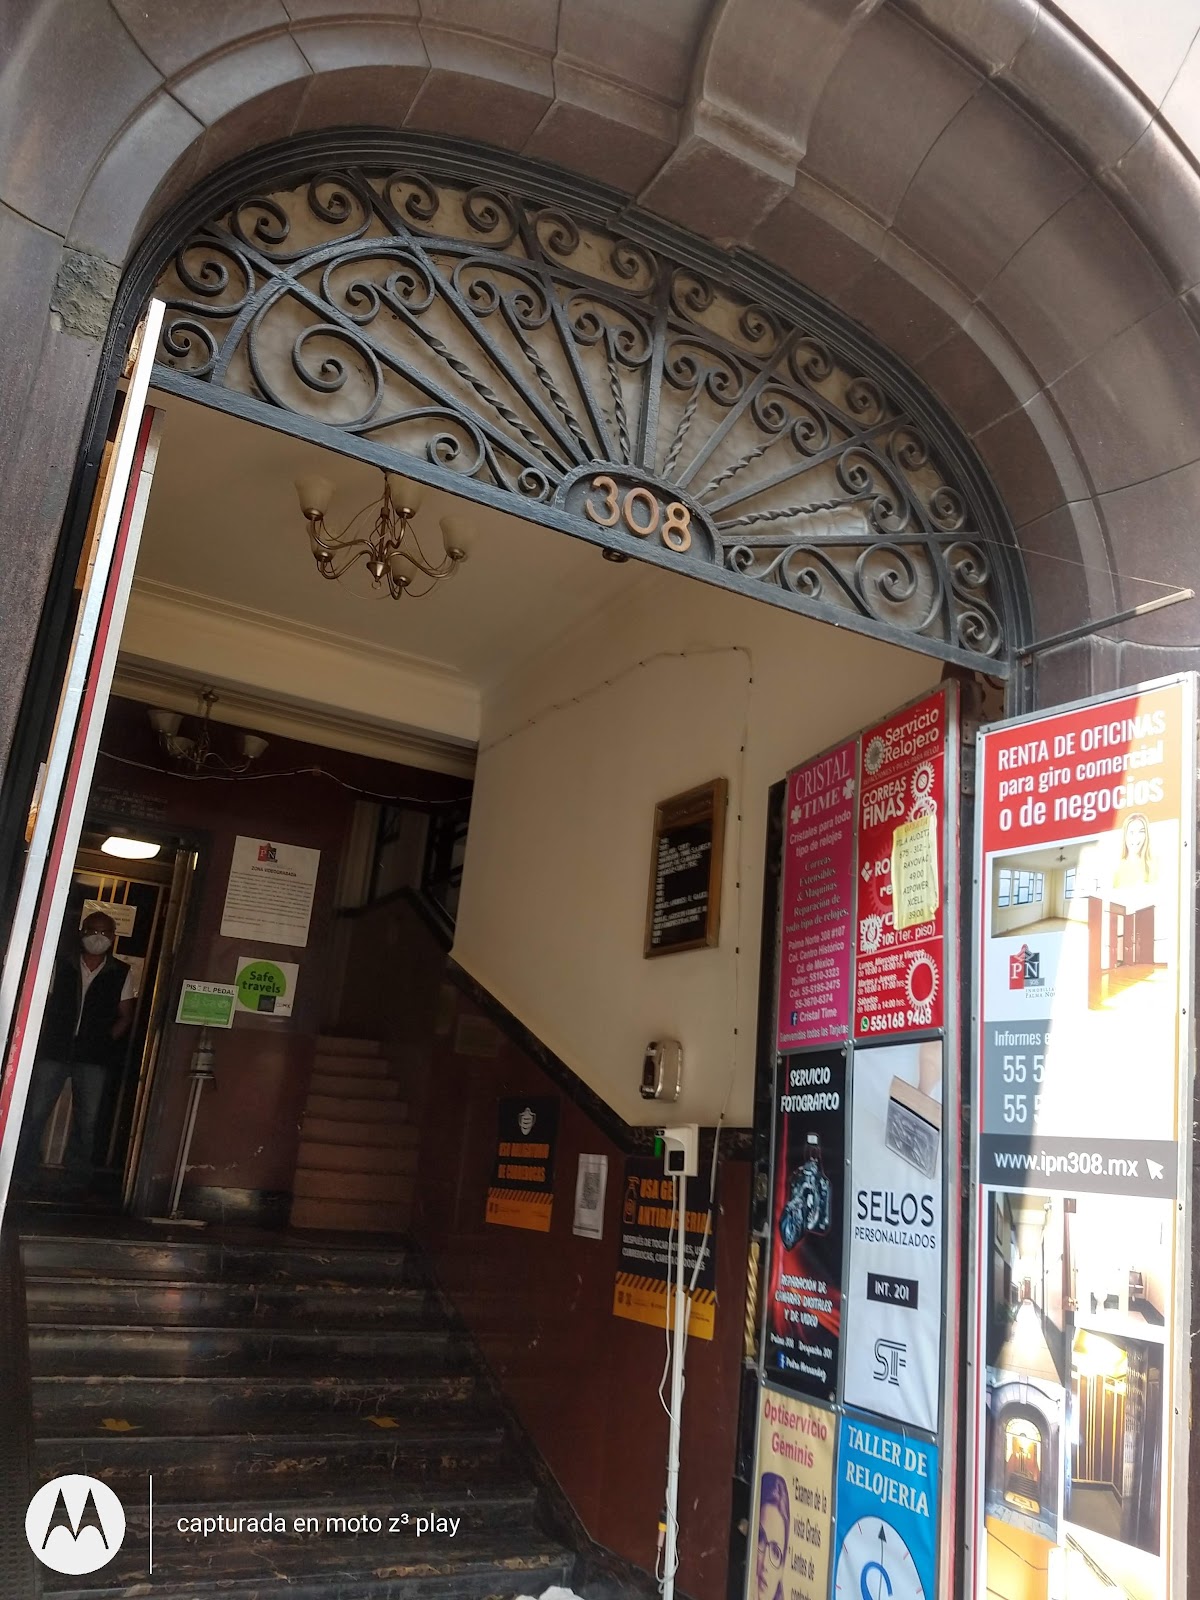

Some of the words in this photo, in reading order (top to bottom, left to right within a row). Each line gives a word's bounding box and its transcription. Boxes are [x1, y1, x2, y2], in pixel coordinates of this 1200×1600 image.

[586, 475, 692, 553] 308
[885, 708, 939, 746] Servicio
[883, 727, 939, 764] Relojero
[998, 740, 1049, 771] RENTA
[1054, 732, 1076, 759] DE
[1080, 709, 1166, 752] OFICINAS
[795, 750, 850, 801] CRISTAL
[999, 775, 1034, 802] para
[1038, 766, 1071, 793] giro
[1076, 740, 1164, 781] comercial
[803, 787, 840, 819] TIME
[862, 776, 907, 807] CORREAS
[1000, 808, 1012, 831] o
[1019, 796, 1046, 828] de
[1054, 776, 1164, 822] negocios
[863, 792, 905, 830] FINAS
[789, 826, 818, 845] Cristales
[818, 819, 834, 835] para
[834, 810, 852, 825] todo
[796, 845, 809, 858] tipo
[809, 840, 819, 851] de
[819, 830, 843, 848] relojes
[804, 856, 831, 871] Correas
[831, 894, 841, 904] de
[814, 914, 824, 925] de
[804, 935, 820, 946] Norte
[882, 932, 895, 946] 106
[895, 930, 914, 946] (1er.
[915, 922, 936, 940] piso)
[799, 949, 818, 960] Centro
[806, 962, 814, 972] de
[242, 980, 281, 994] travels
[250, 970, 275, 983] Safe
[202, 985, 212, 993] EL
[212, 987, 235, 996] PEDAL
[799, 1009, 820, 1022] Cristal
[821, 1007, 838, 1018] Time
[870, 1011, 905, 1032] 556168
[906, 1007, 932, 1027] 9468
[995, 1030, 1042, 1047] Informes
[790, 1066, 831, 1087] SERVICIO
[1003, 1055, 1027, 1083] 55
[780, 1091, 840, 1113] FOTOGRAFICO
[1003, 1094, 1027, 1123] 55
[994, 1150, 1139, 1178] www.ipn308.mx
[640, 1178, 660, 1200] USA
[857, 1190, 934, 1227] SELLOS
[644, 1238, 652, 1247] DE
[855, 1226, 936, 1249] PERSONALIZADOS
[817, 1281, 828, 1295] DE
[874, 1280, 892, 1298] INT.
[894, 1283, 910, 1301] 201
[784, 1308, 790, 1321] Y
[790, 1309, 800, 1323] DE
[764, 1398, 828, 1442] Optiservicio
[848, 1424, 902, 1468] TALLER
[904, 1446, 928, 1478] DE
[845, 1460, 930, 1518] RELOJERIA
[805, 1518, 821, 1548] Gratis
[807, 1555, 815, 1581] de
